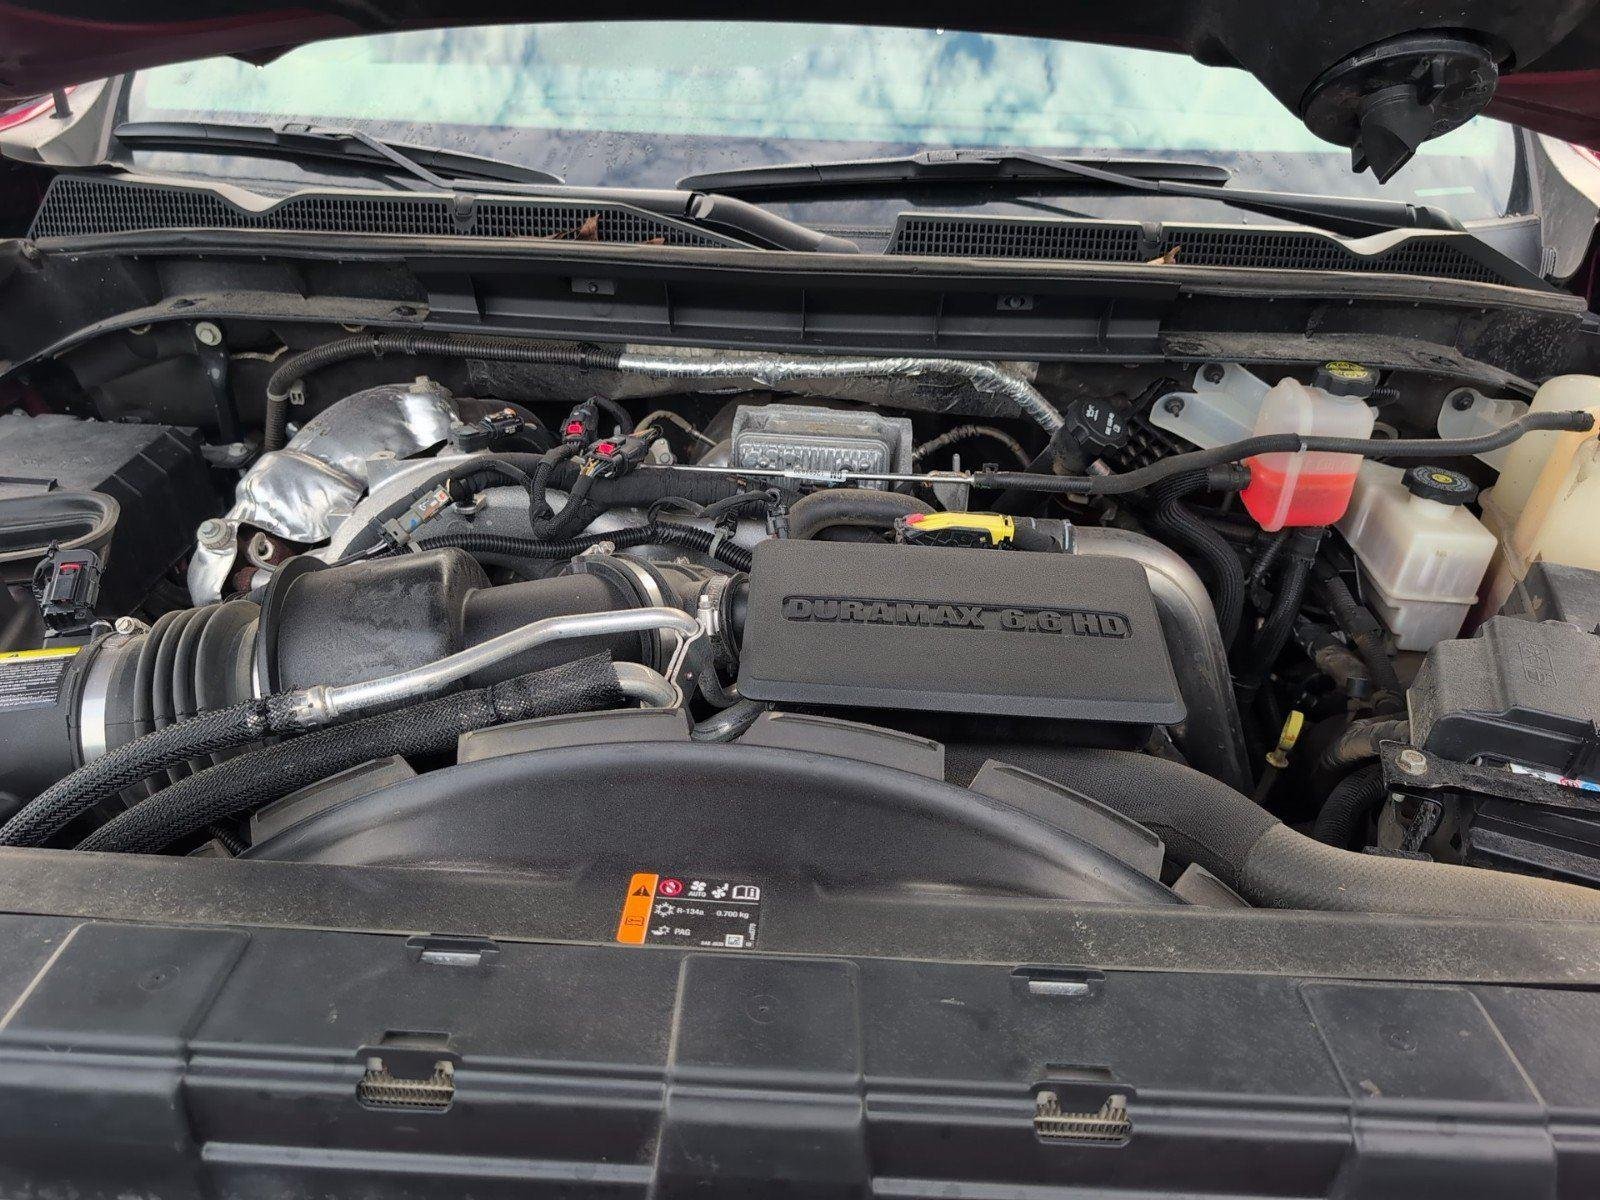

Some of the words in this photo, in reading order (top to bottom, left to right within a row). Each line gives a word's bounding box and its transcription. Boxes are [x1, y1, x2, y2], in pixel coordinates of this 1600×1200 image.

[785, 597, 985, 629] DURAMAX
[1000, 606, 1064, 633] 6.6
[1071, 611, 1128, 637] HD
[688, 890, 707, 898] AUTO
[676, 907, 704, 916] R-134a
[739, 911, 750, 919] kg
[674, 928, 691, 936] PAG
